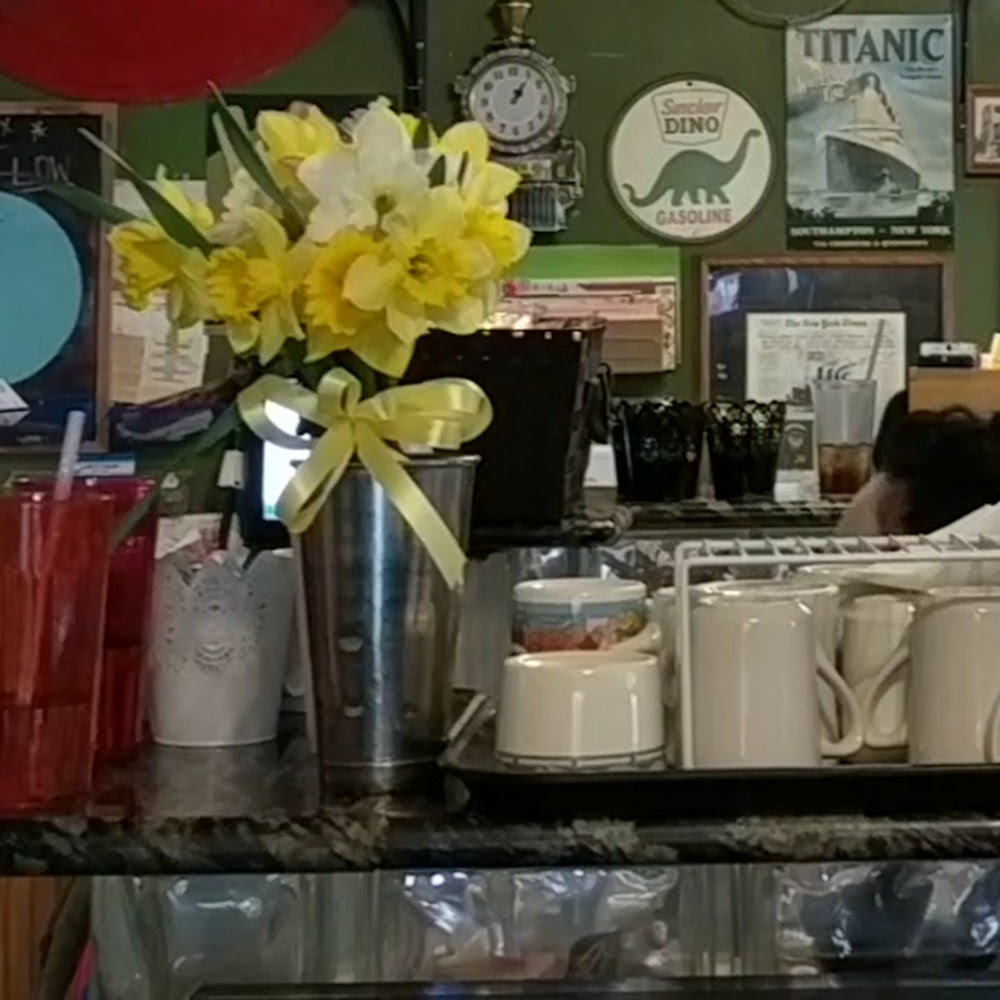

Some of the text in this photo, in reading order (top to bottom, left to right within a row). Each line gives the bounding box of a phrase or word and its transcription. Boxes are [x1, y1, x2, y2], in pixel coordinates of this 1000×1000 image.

[796, 27, 946, 64] TITANIC
[663, 115, 720, 135] DINO
[655, 207, 733, 227] GASOLINE
